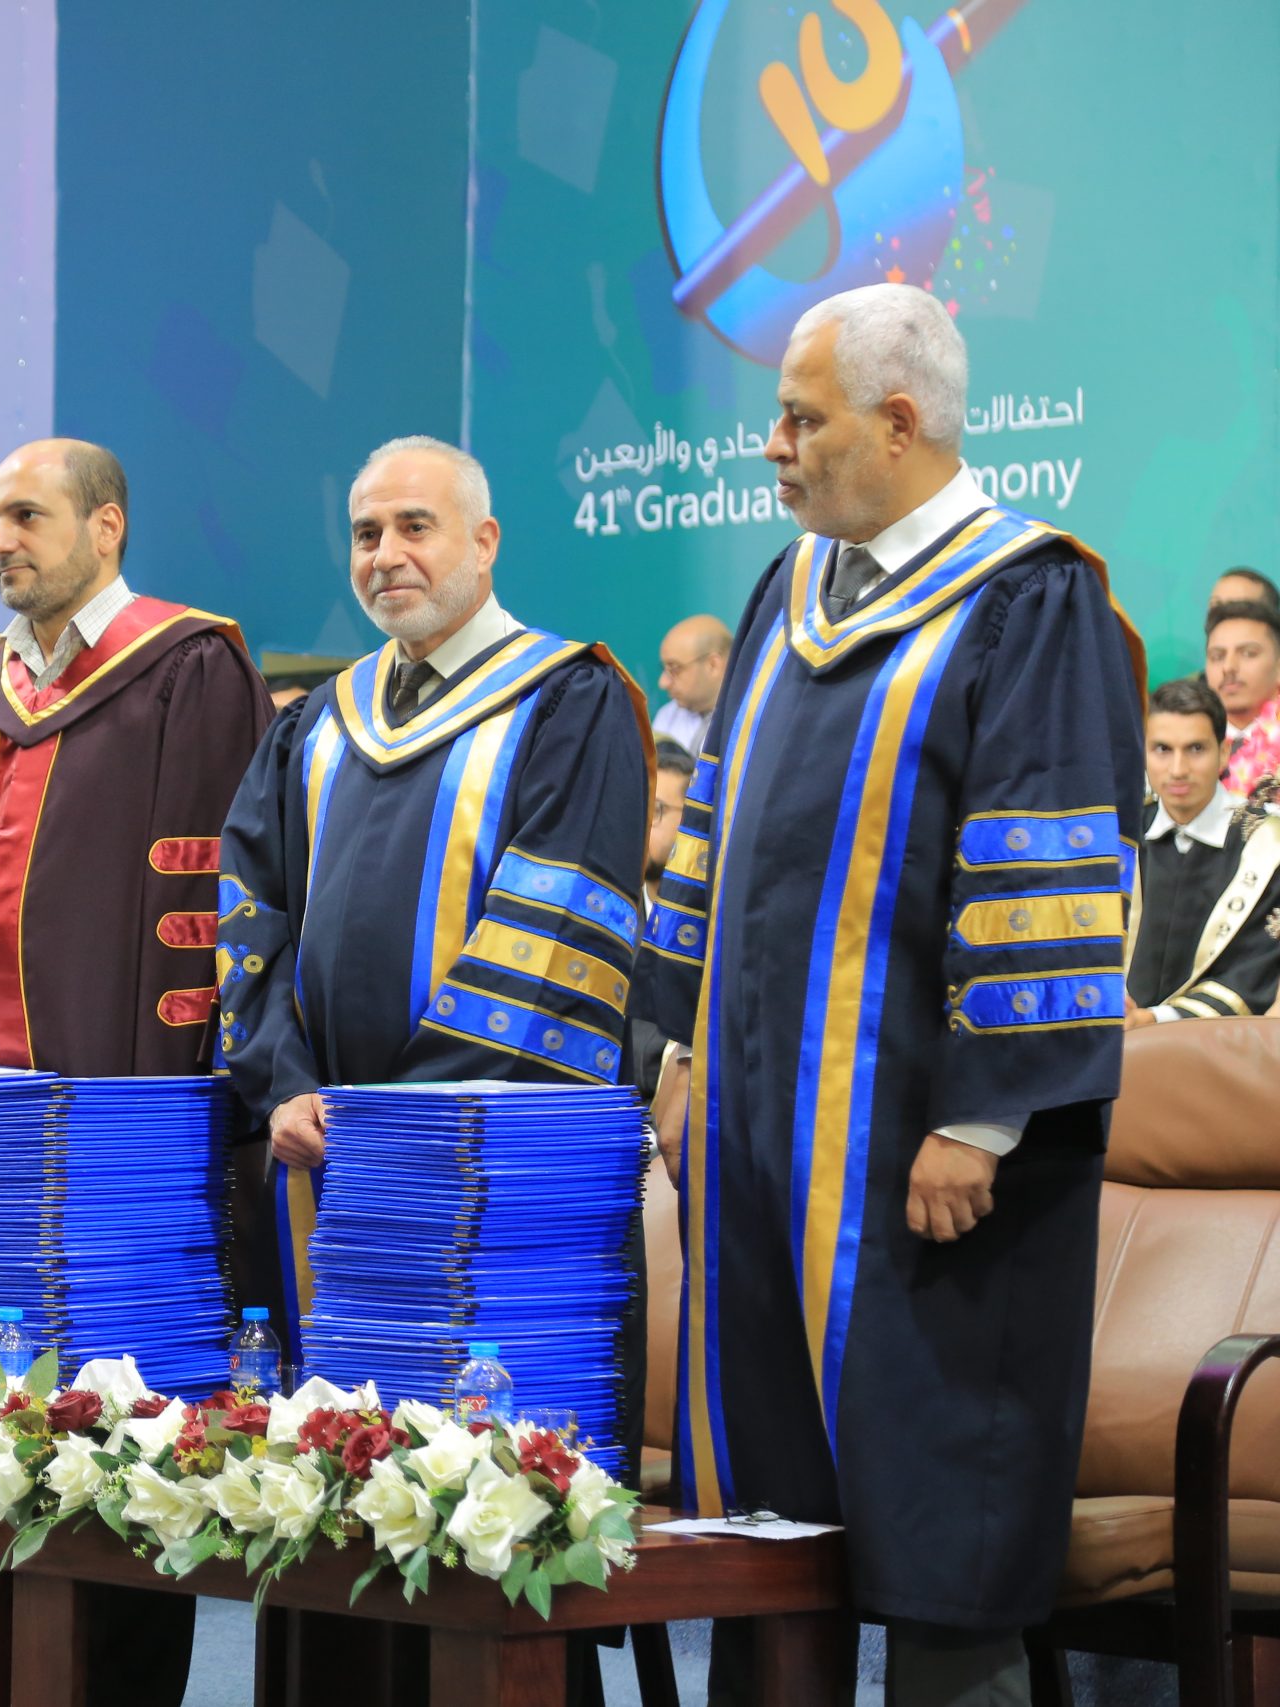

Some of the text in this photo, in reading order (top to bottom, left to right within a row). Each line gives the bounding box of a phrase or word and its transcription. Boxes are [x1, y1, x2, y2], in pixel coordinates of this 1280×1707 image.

[964, 386, 1084, 435] احتفالات
[575, 421, 691, 482] والأربعين
[634, 477, 790, 532] Graduat
[968, 457, 1083, 511] mony
